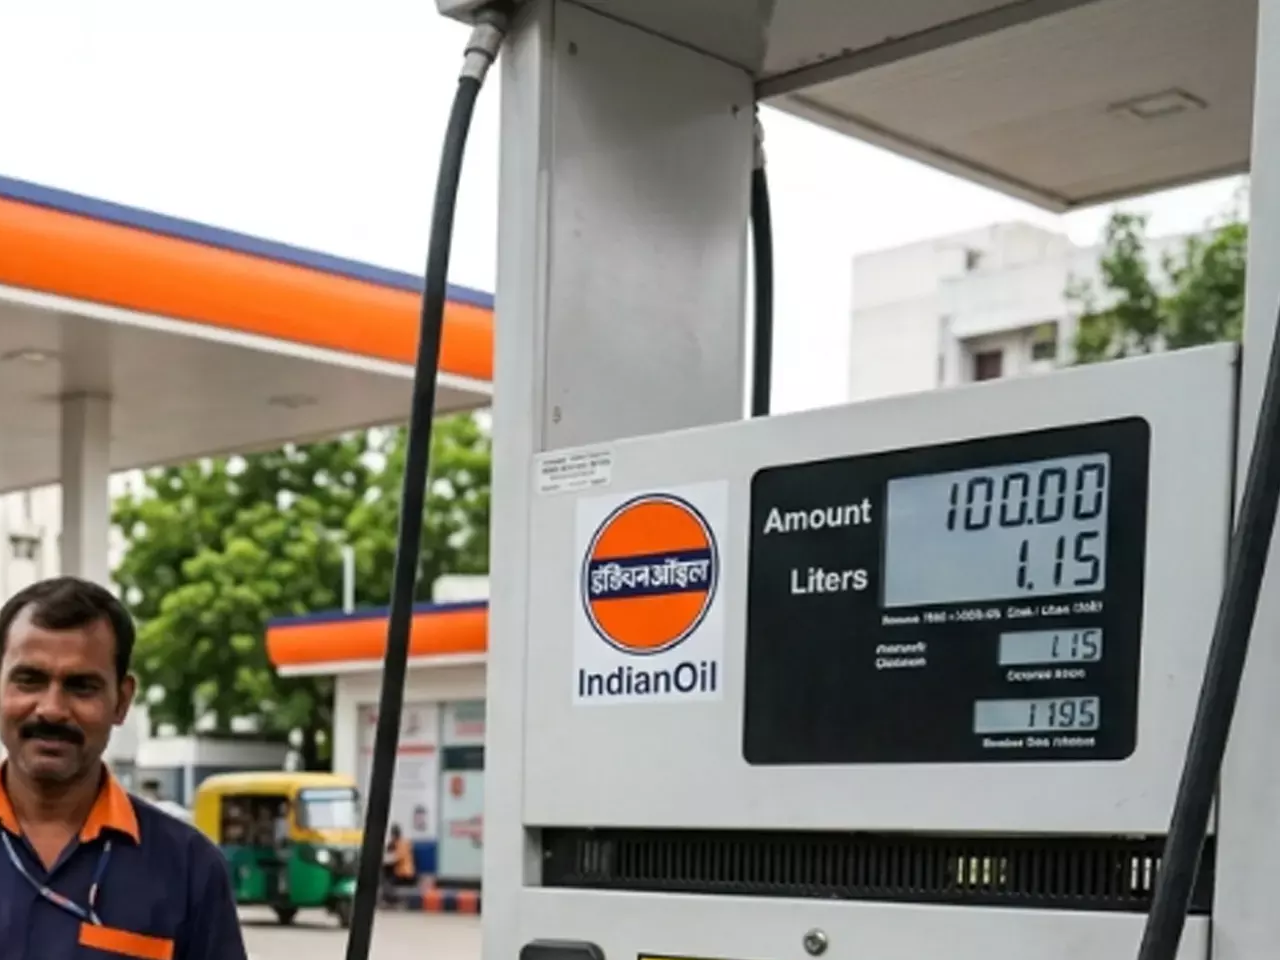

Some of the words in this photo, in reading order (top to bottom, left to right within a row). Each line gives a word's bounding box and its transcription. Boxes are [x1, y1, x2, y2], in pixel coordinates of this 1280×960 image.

[947, 463, 1105, 531] 100.00
[763, 498, 872, 534] Amount
[1017, 531, 1100, 590] 1.15
[790, 567, 869, 594] Liters
[578, 660, 717, 697] IndianOil
